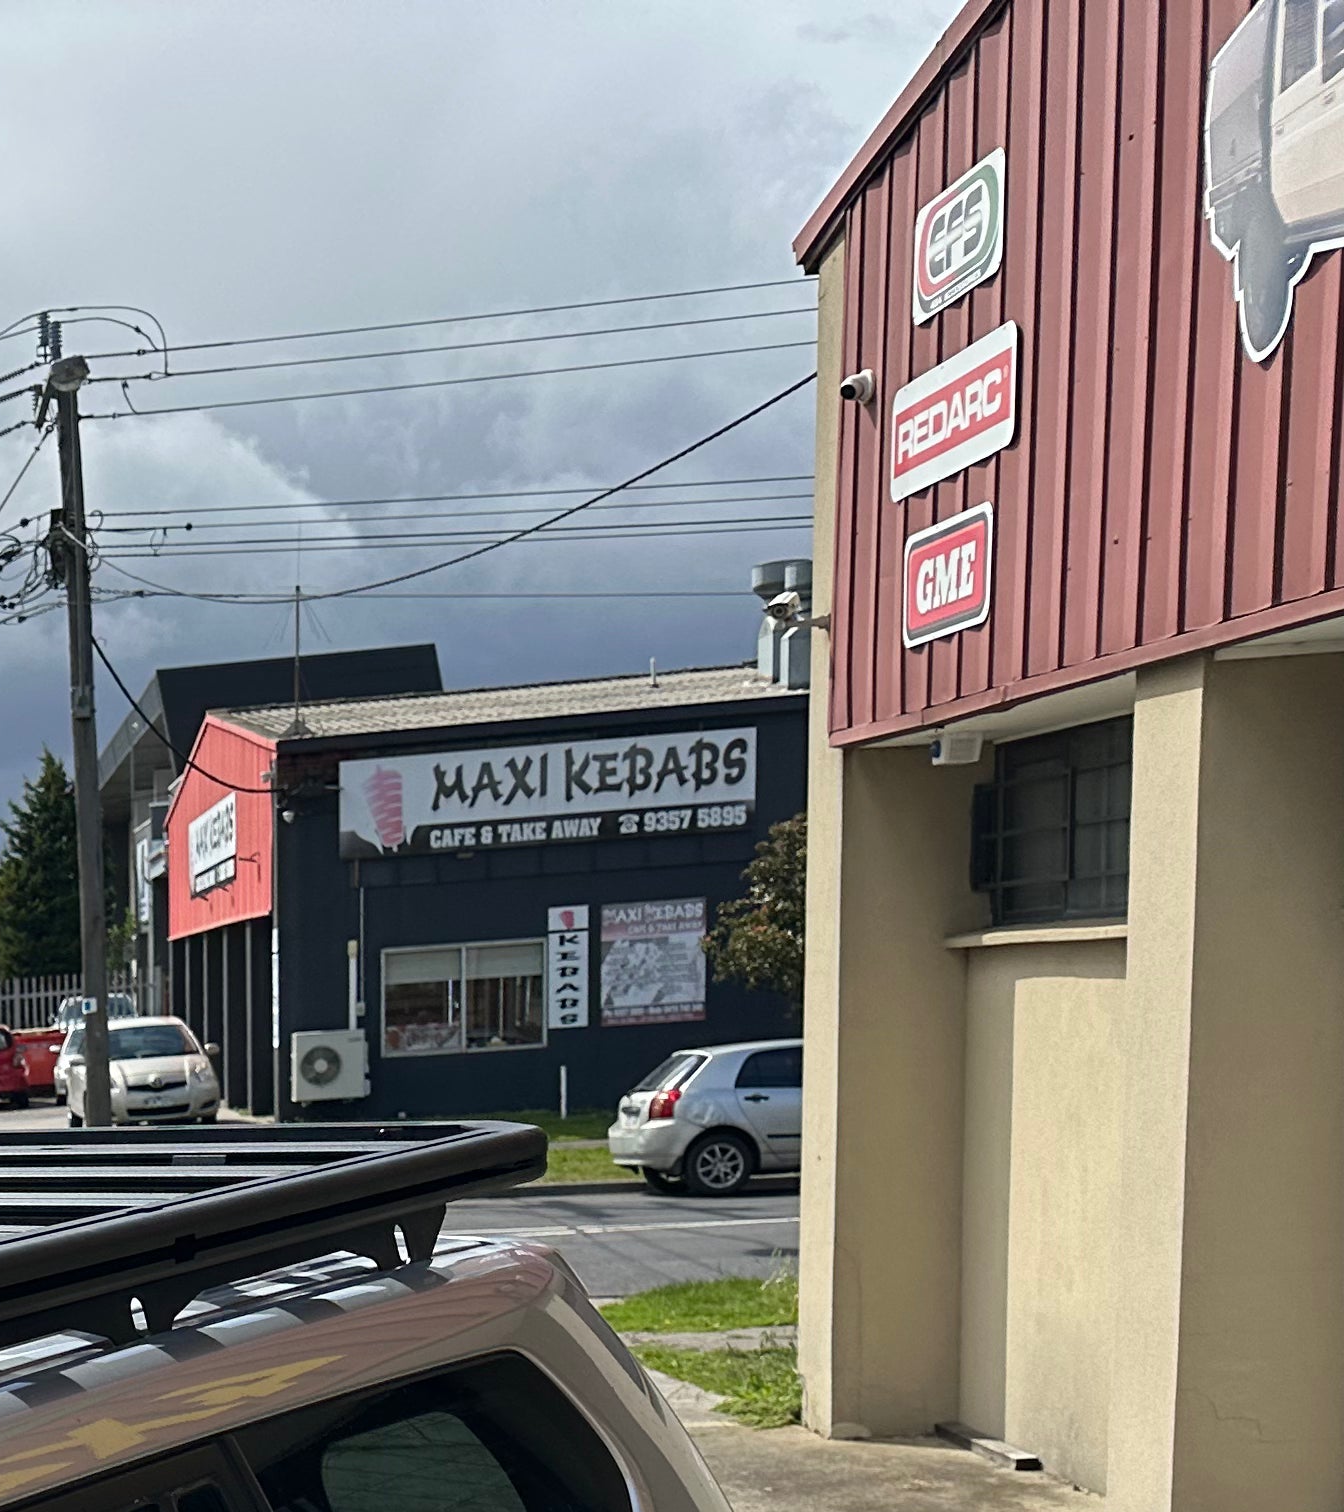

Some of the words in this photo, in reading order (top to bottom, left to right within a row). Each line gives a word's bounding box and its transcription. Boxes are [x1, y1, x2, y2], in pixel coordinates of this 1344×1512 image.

[898, 368, 1002, 464] REDARC
[916, 540, 976, 614] GME
[431, 753, 548, 811] MAXI
[565, 737, 748, 802] KEBABS
[430, 826, 476, 849] CAFE
[480, 825, 493, 844] &
[498, 822, 546, 843] TAKE
[551, 817, 601, 839] AWAY
[643, 809, 692, 832] 9357
[697, 805, 747, 828] 5895
